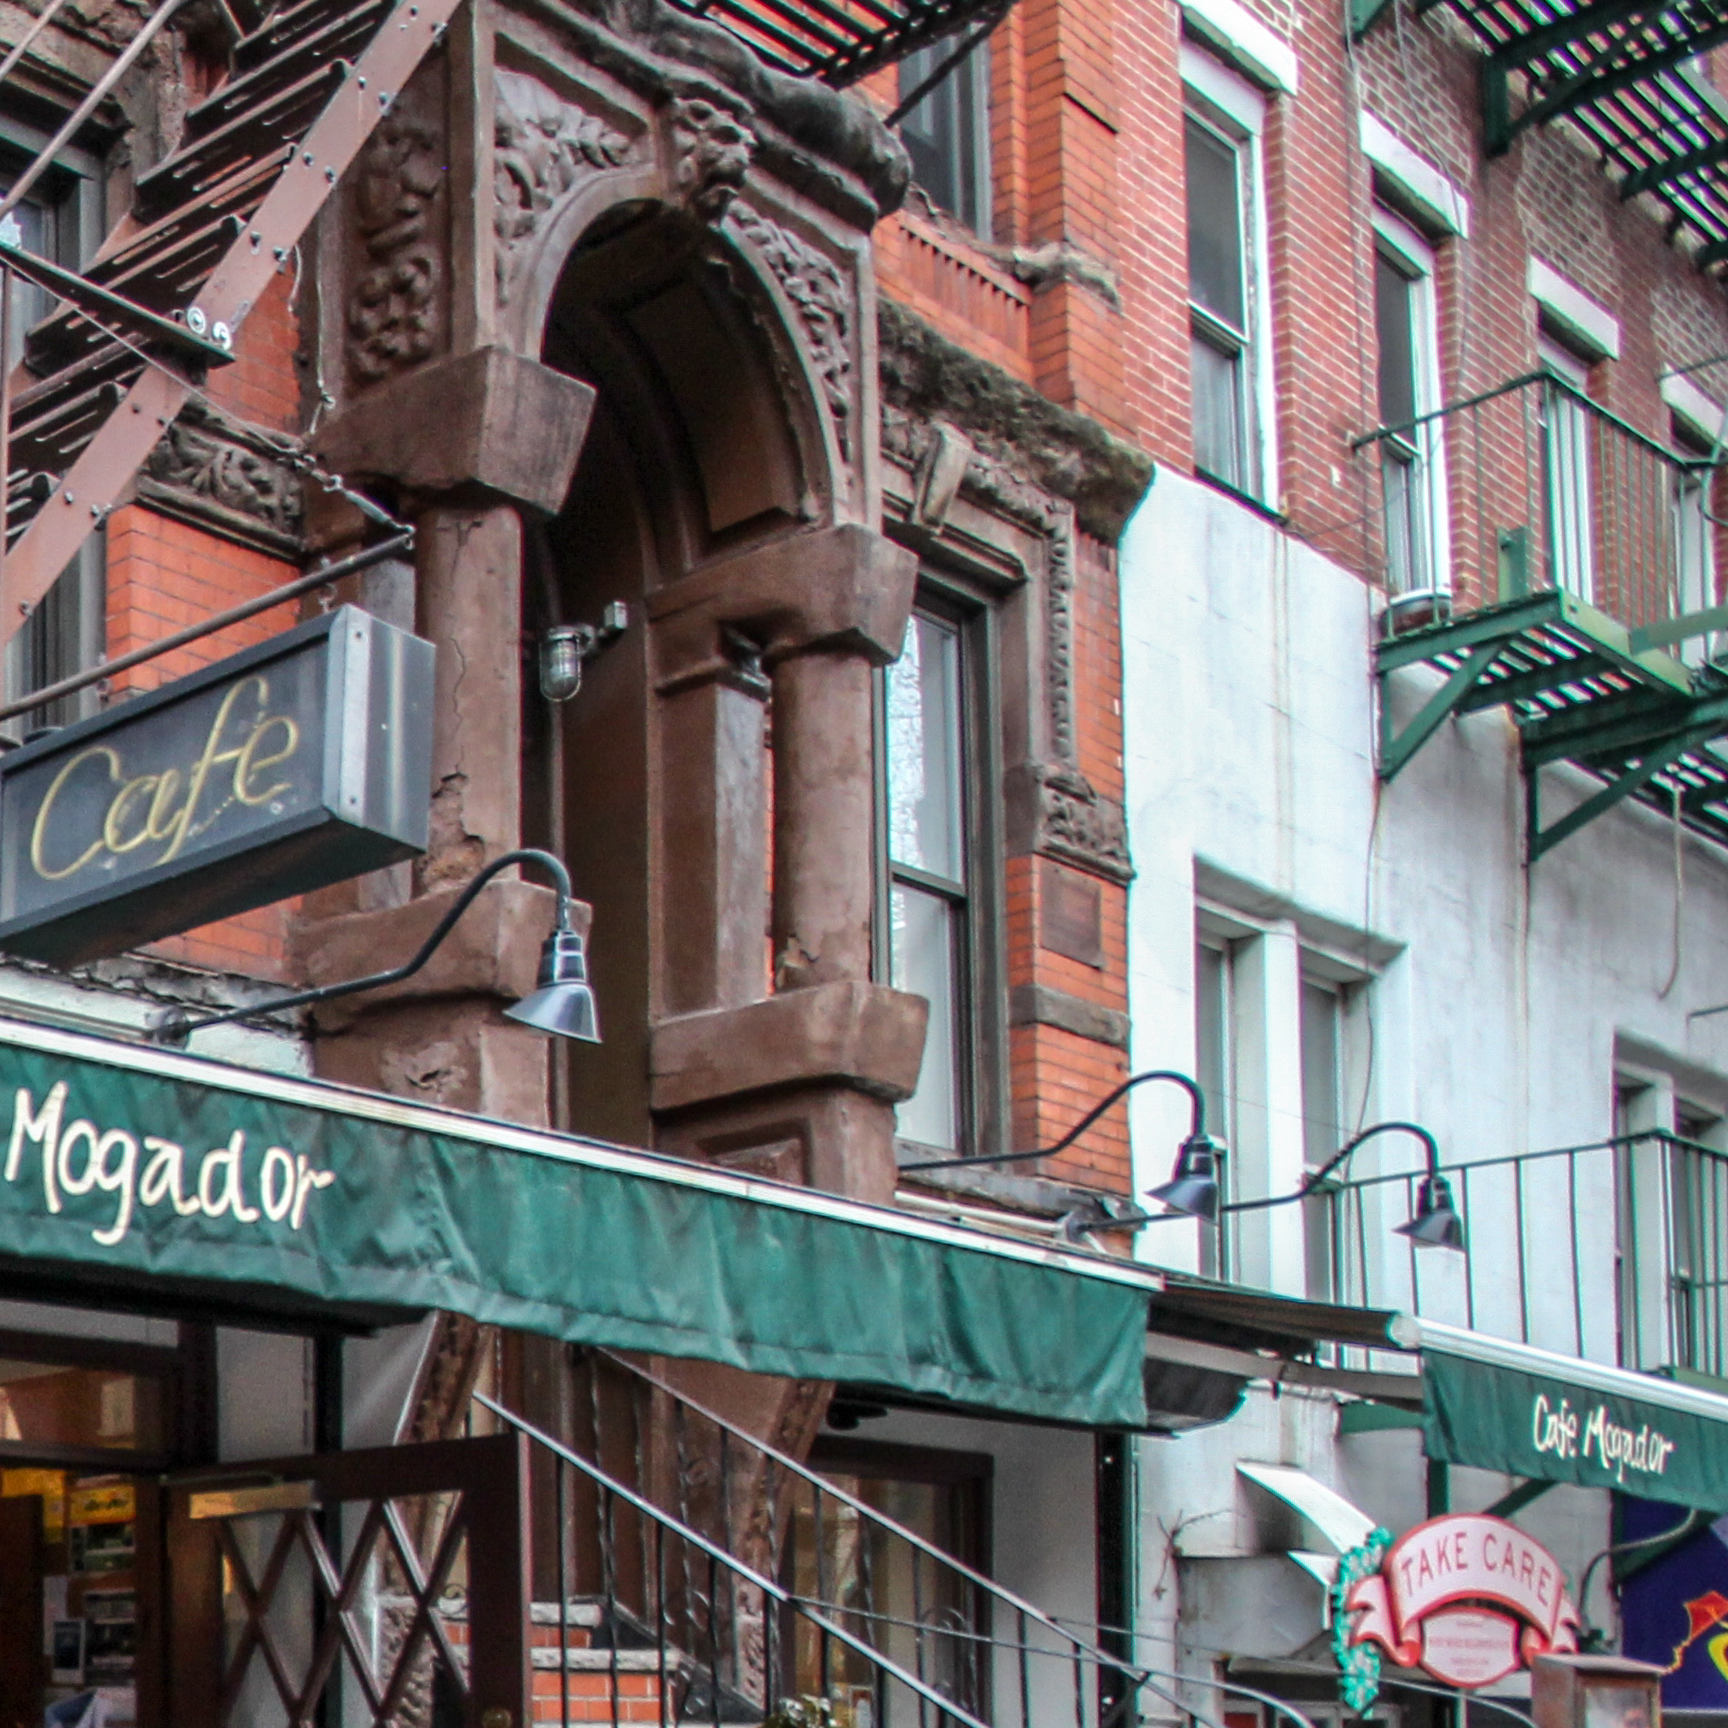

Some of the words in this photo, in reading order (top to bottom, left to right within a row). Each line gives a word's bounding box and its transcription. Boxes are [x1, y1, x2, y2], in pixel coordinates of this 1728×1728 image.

[30, 676, 300, 881] Cafe
[4, 1080, 337, 1246] Mogador
[1532, 1393, 1580, 1460] Cafe
[1581, 1404, 1677, 1485] Mogador
[1400, 1531, 1469, 1599] TAKE
[1482, 1532, 1553, 1608] CARE
